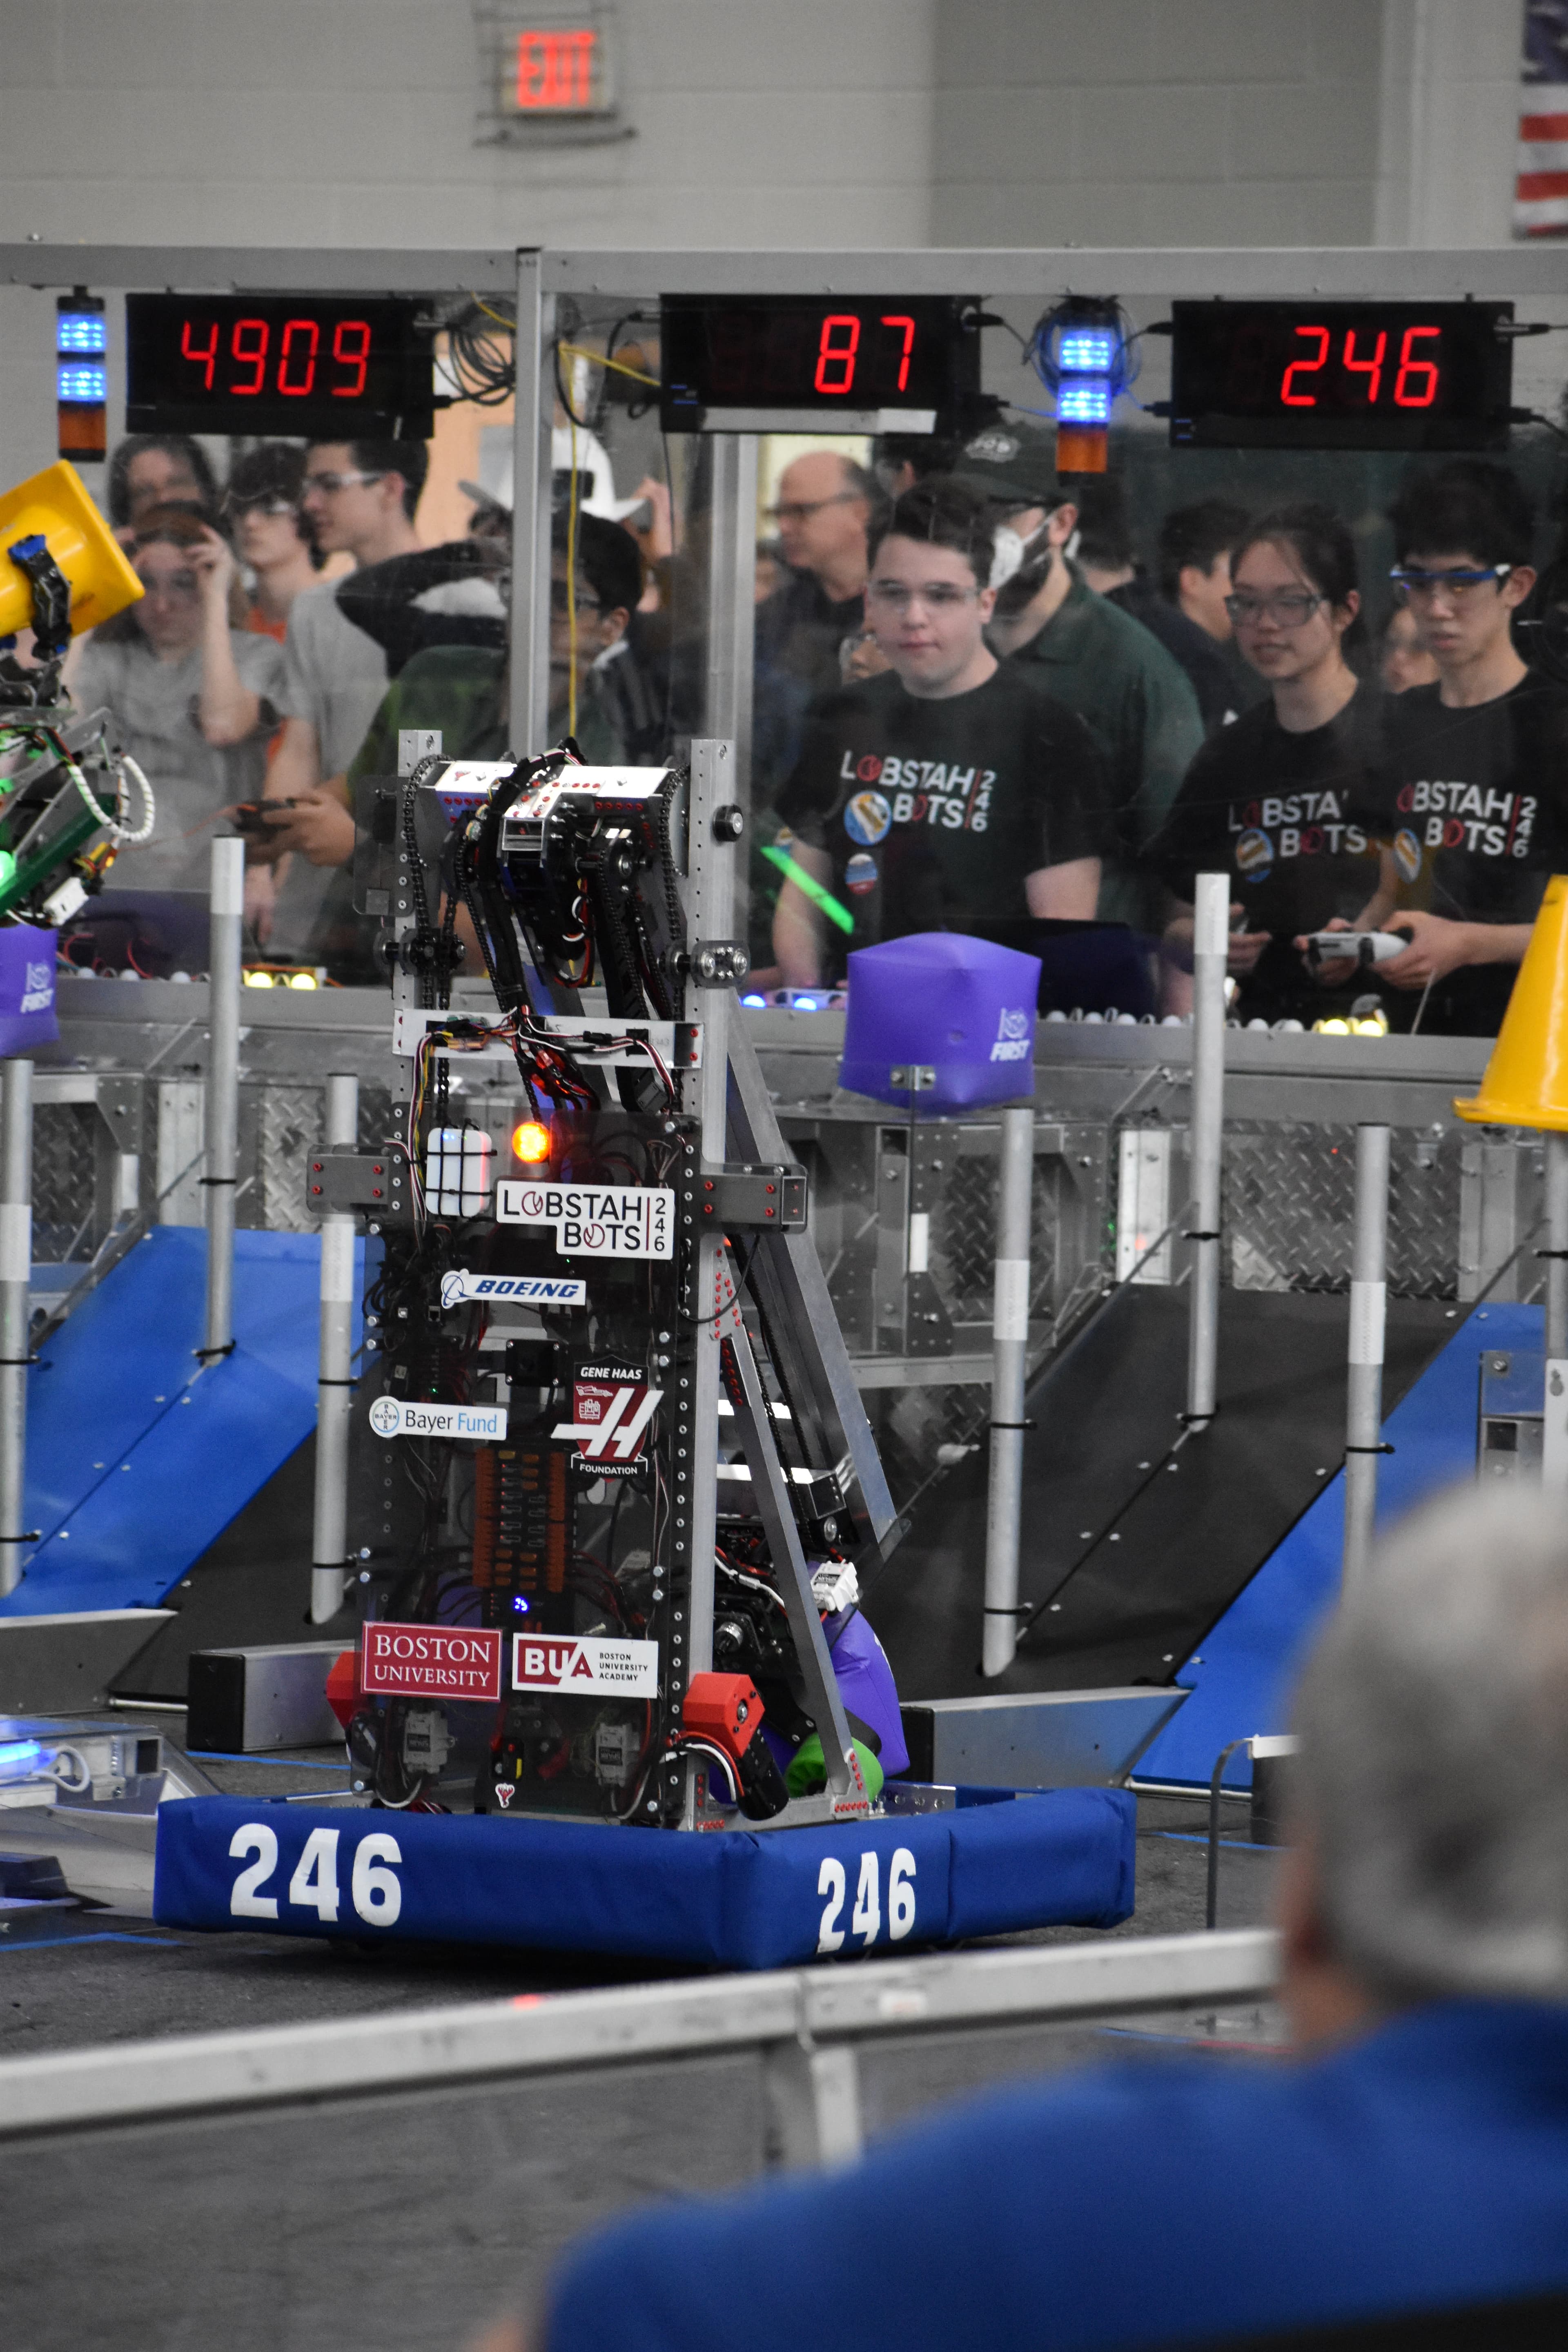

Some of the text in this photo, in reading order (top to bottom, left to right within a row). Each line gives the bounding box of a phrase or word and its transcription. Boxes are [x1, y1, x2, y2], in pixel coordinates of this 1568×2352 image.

[182, 320, 370, 397] 4909
[813, 315, 915, 394] 87
[1281, 326, 1442, 407] 246
[840, 750, 975, 795] LOBSTAH
[893, 792, 965, 829] BOTS
[1228, 790, 1349, 832] LOBSTA
[1396, 780, 1513, 822] OBSTAH
[1280, 824, 1367, 857] BOTS
[1424, 817, 1507, 856] BOTS
[503, 1189, 642, 1221] LOBSTAH
[564, 1222, 641, 1250] BOTS
[475, 1280, 579, 1298] BOEING
[581, 1367, 642, 1380] GENE HAAS
[405, 1410, 497, 1433] Bayer Fund
[580, 1463, 637, 1474] FOUNDATION
[374, 1634, 491, 1663] BOSTON
[525, 1648, 594, 1679] BUA
[599, 1653, 631, 1661] BOSTON
[374, 1665, 490, 1687] UNIVERSITY
[599, 1662, 648, 1672] UNIVERSITY
[599, 1673, 638, 1682] ACADEMY
[229, 1823, 402, 1927] 246
[817, 1848, 916, 1953] 246
